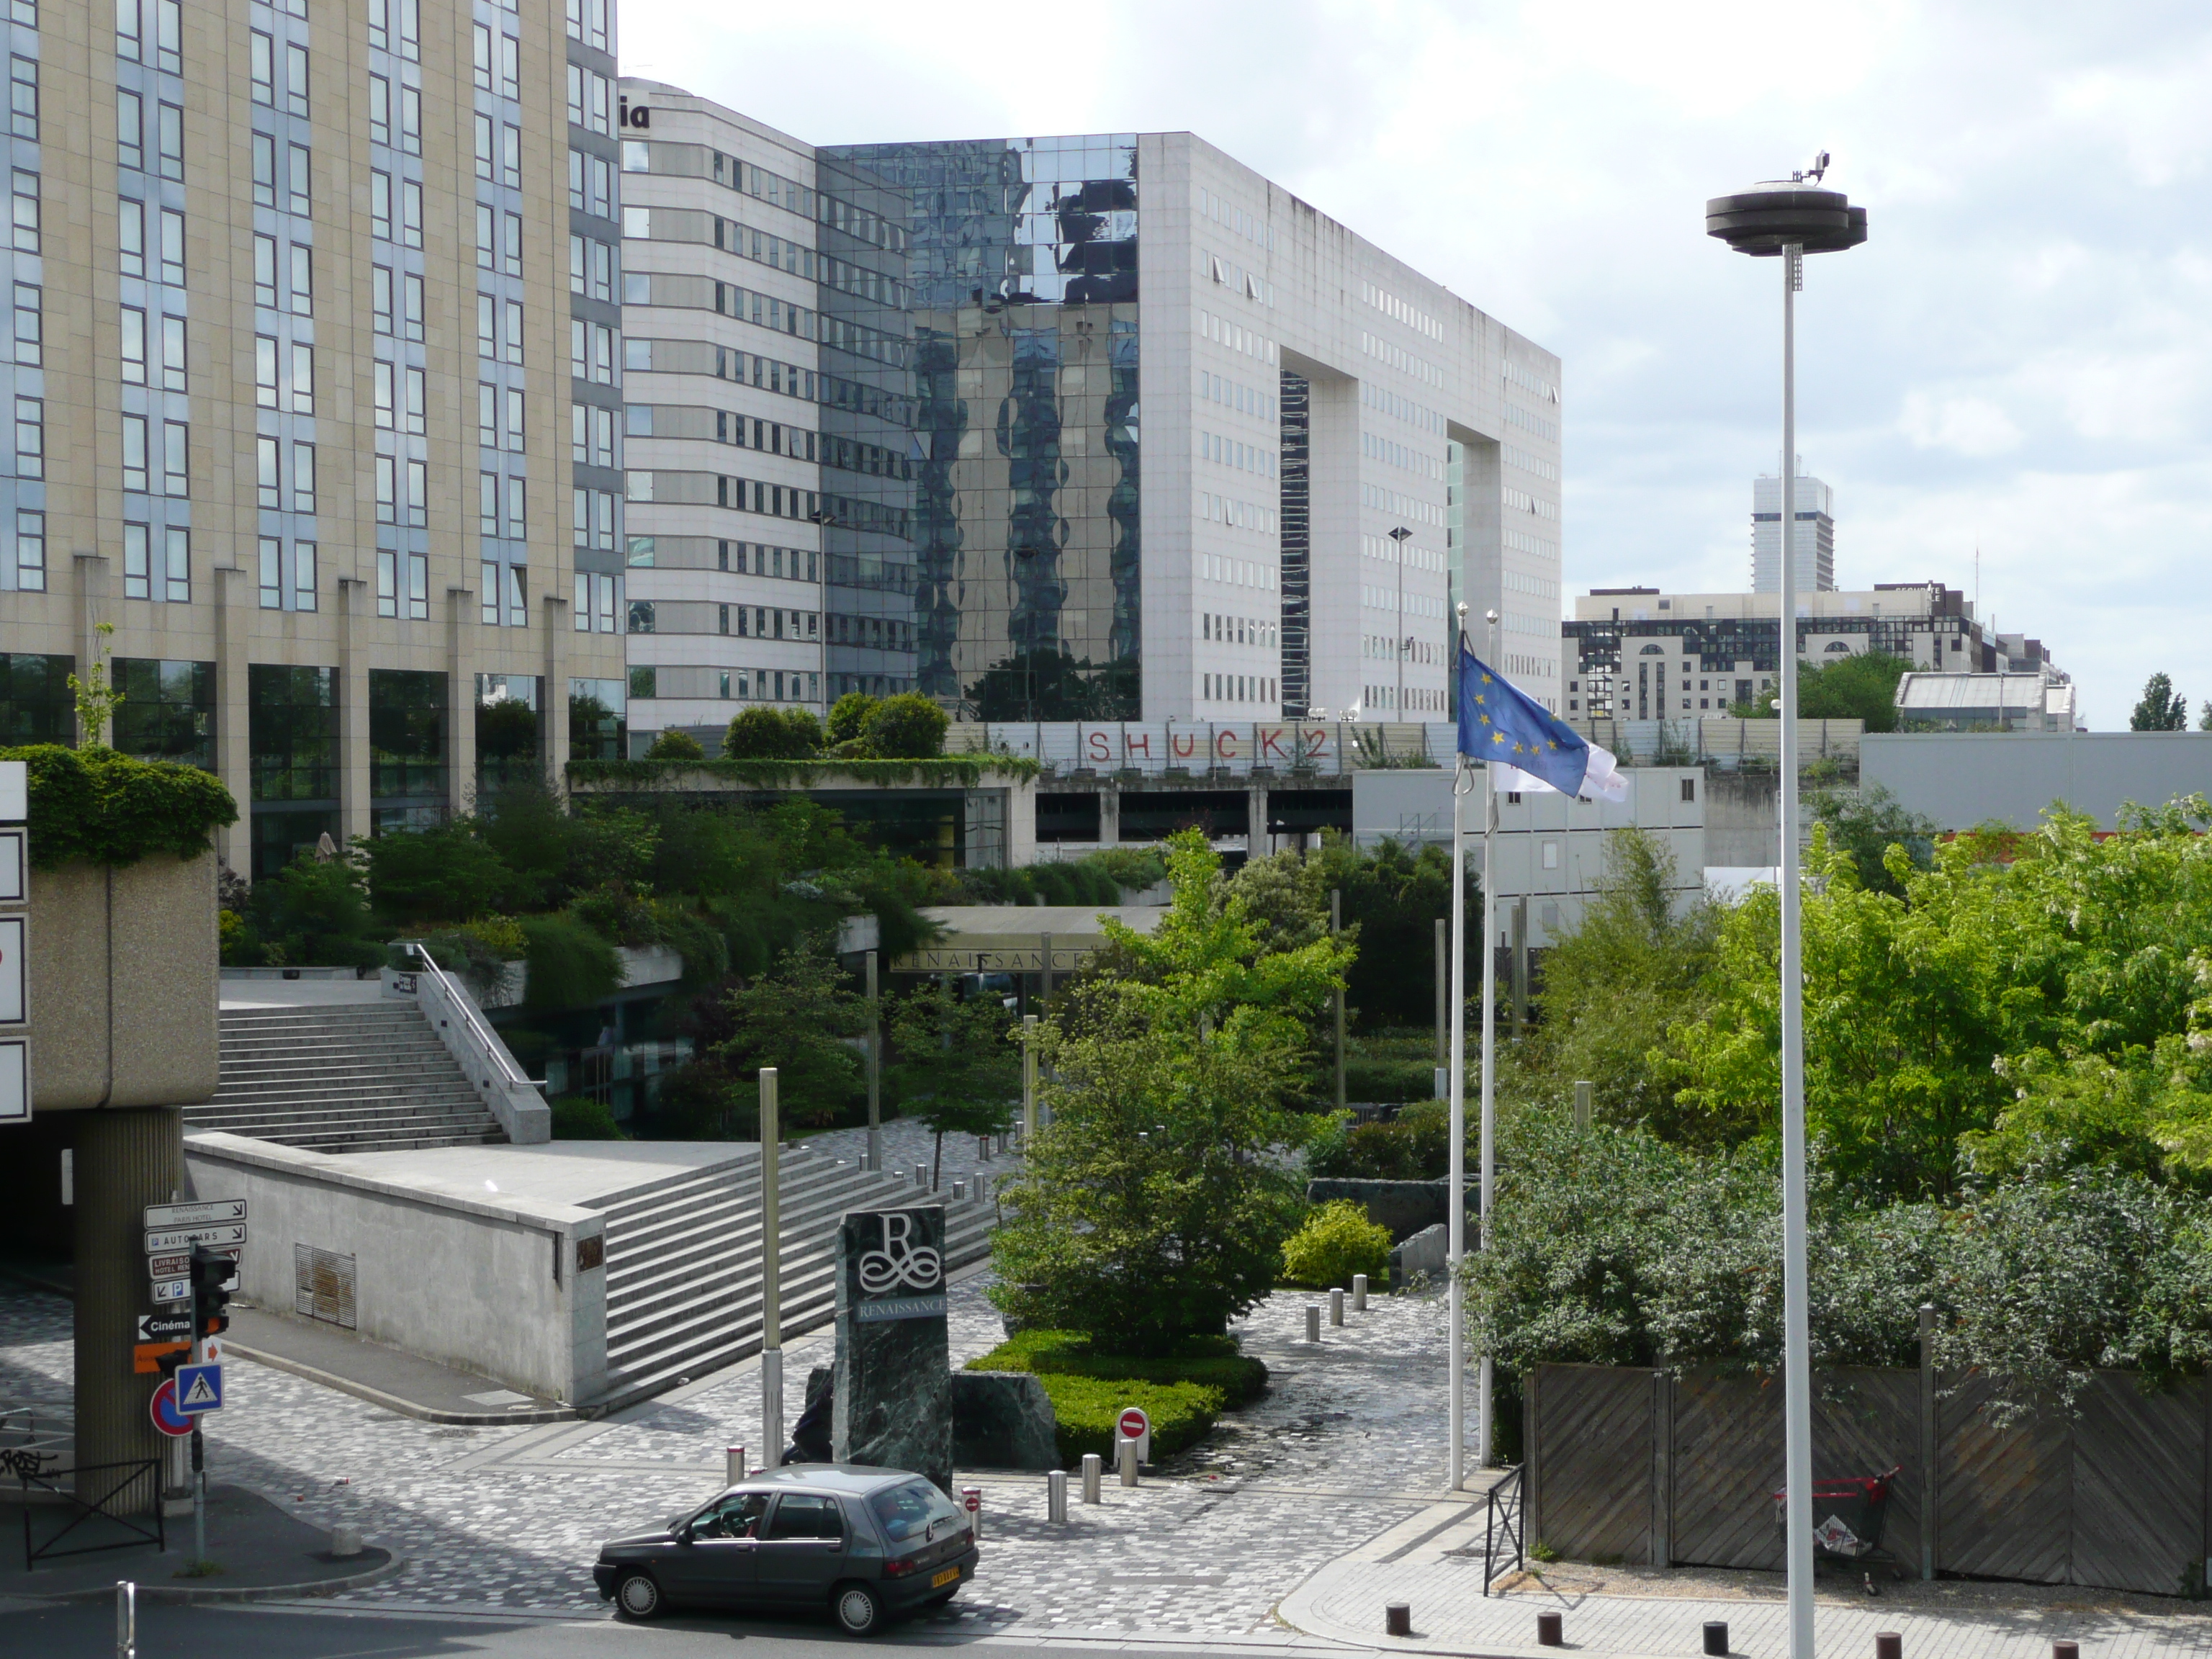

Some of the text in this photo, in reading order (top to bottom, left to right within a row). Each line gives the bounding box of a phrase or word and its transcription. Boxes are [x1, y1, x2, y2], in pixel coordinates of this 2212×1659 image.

[171, 1204, 214, 1213] RENAISSANCE
[860, 1299, 946, 1318] RENAISSANCE
[150, 1320, 190, 1331] Cinéma
